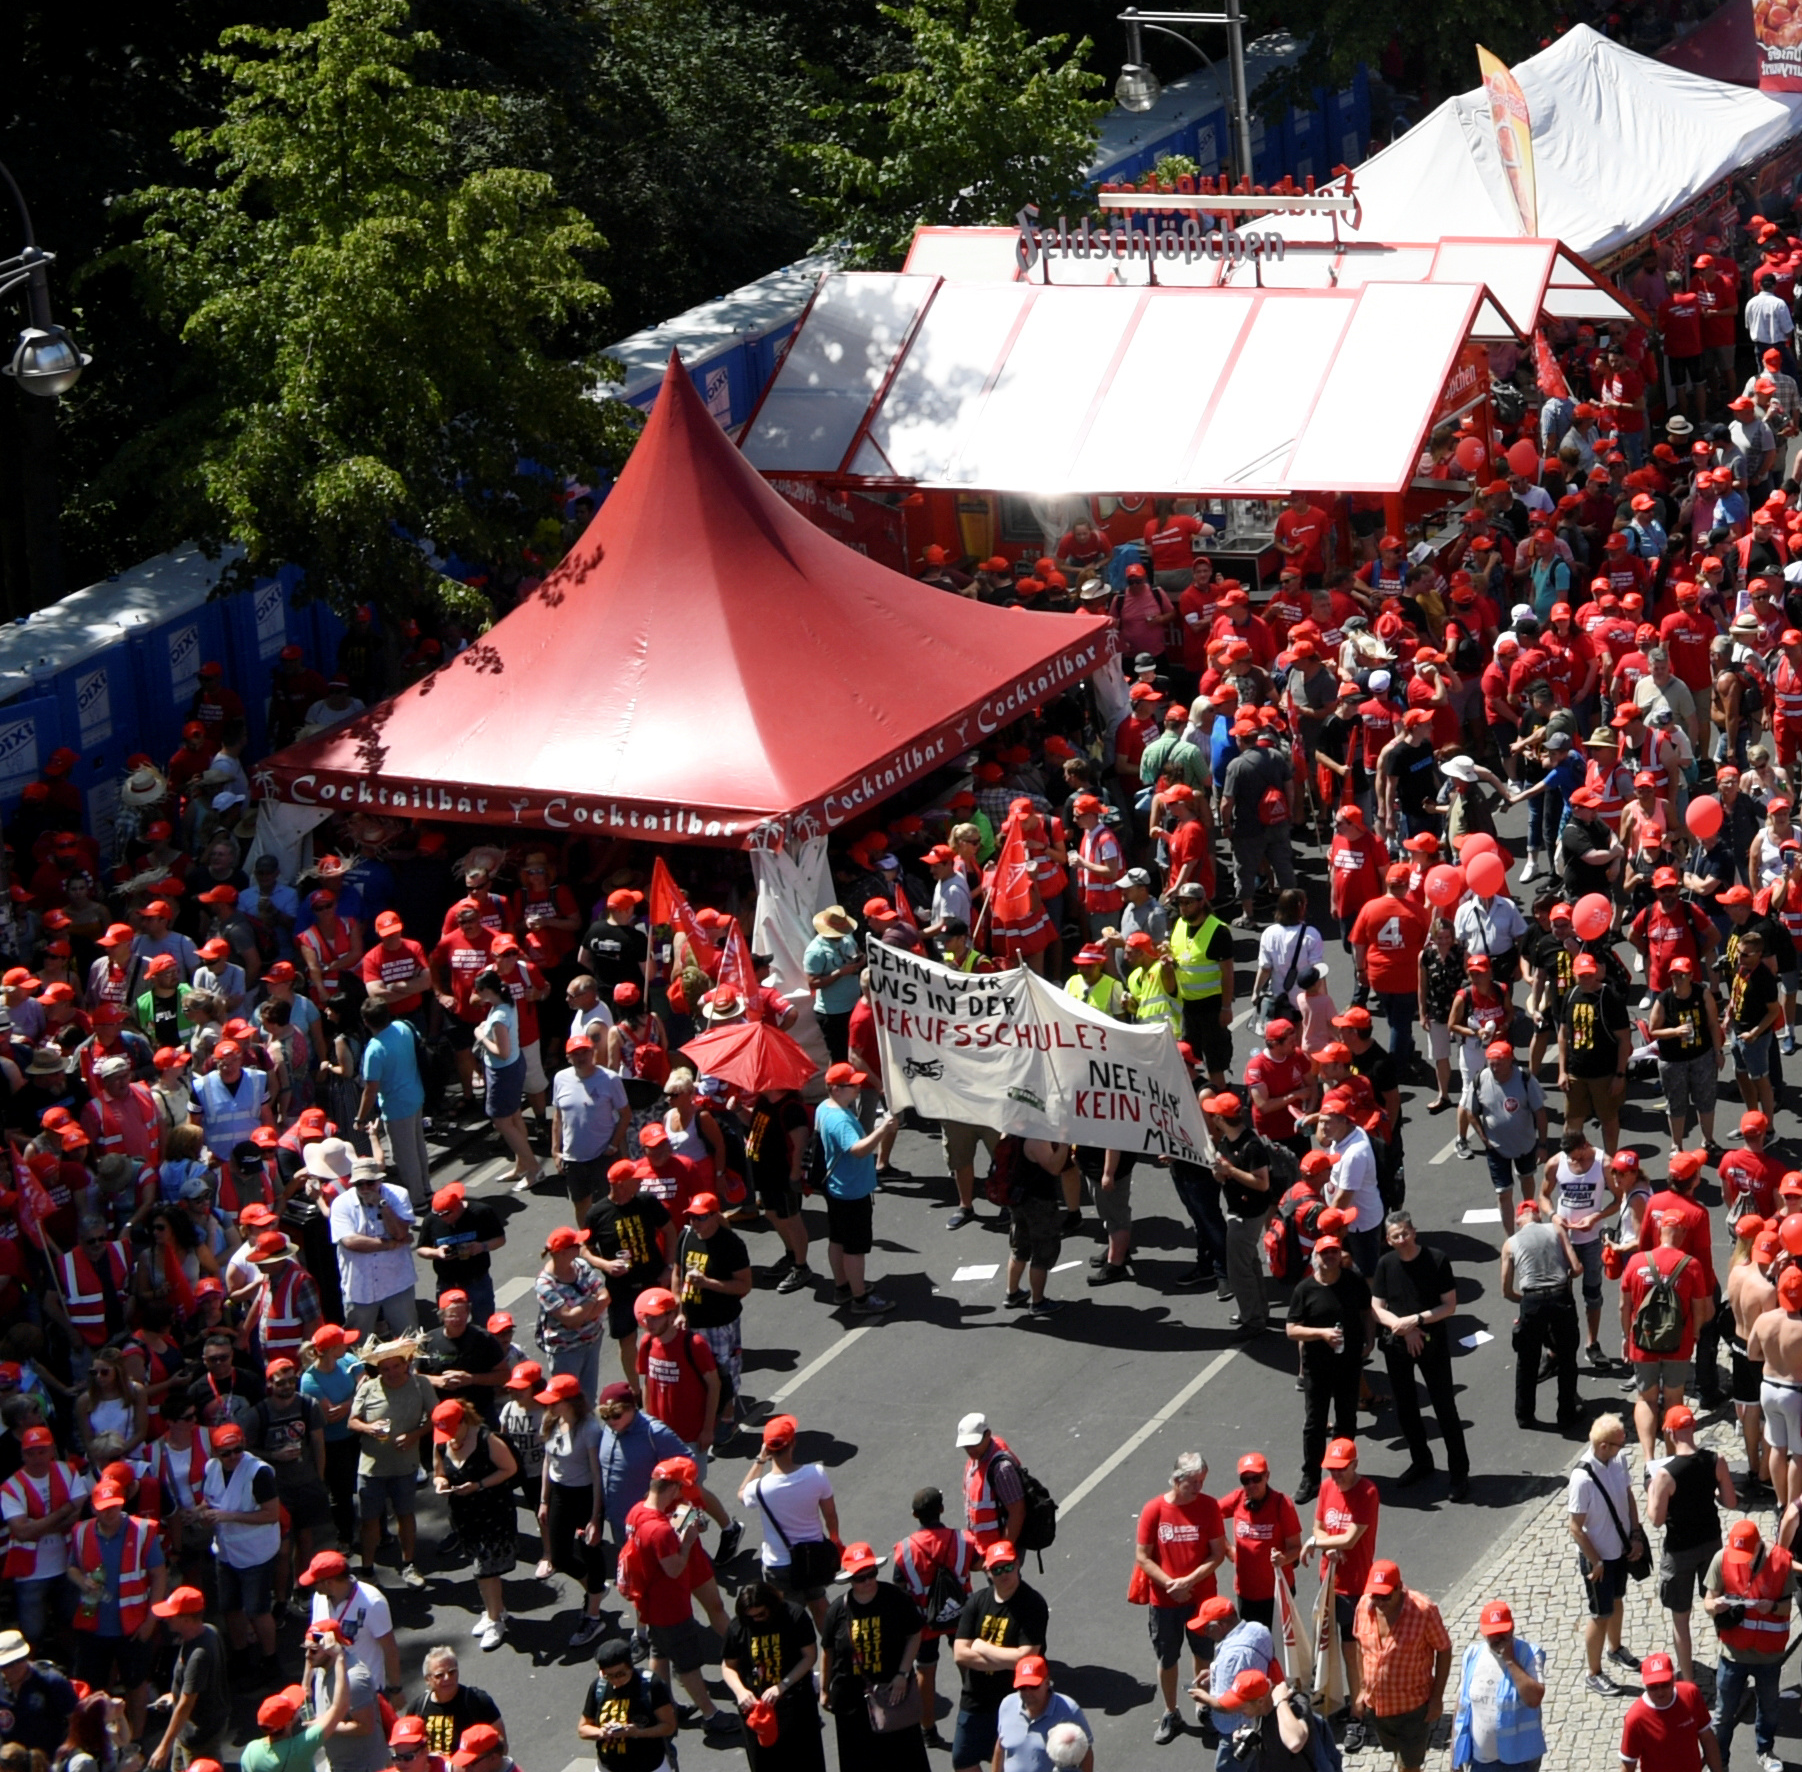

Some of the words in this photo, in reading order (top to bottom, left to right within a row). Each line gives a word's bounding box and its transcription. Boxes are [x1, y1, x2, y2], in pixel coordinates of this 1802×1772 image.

[1015, 203, 1285, 273] Feldschlößchen
[707, 370, 728, 399] DIXI
[256, 584, 282, 622] DIXI
[170, 627, 199, 665] DIXI
[78, 669, 107, 710] DIXI
[977, 644, 1095, 734] Cocktailbar
[291, 775, 488, 814] Cocktailbar
[823, 737, 944, 828] Cocktailbar
[544, 797, 739, 838] Cocktailbar
[1377, 916, 1404, 945] 4
[869, 969, 918, 1006] UNS
[928, 991, 957, 1016] IN
[969, 994, 1016, 1017] DER
[1075, 1089, 1141, 1123] KEIN
